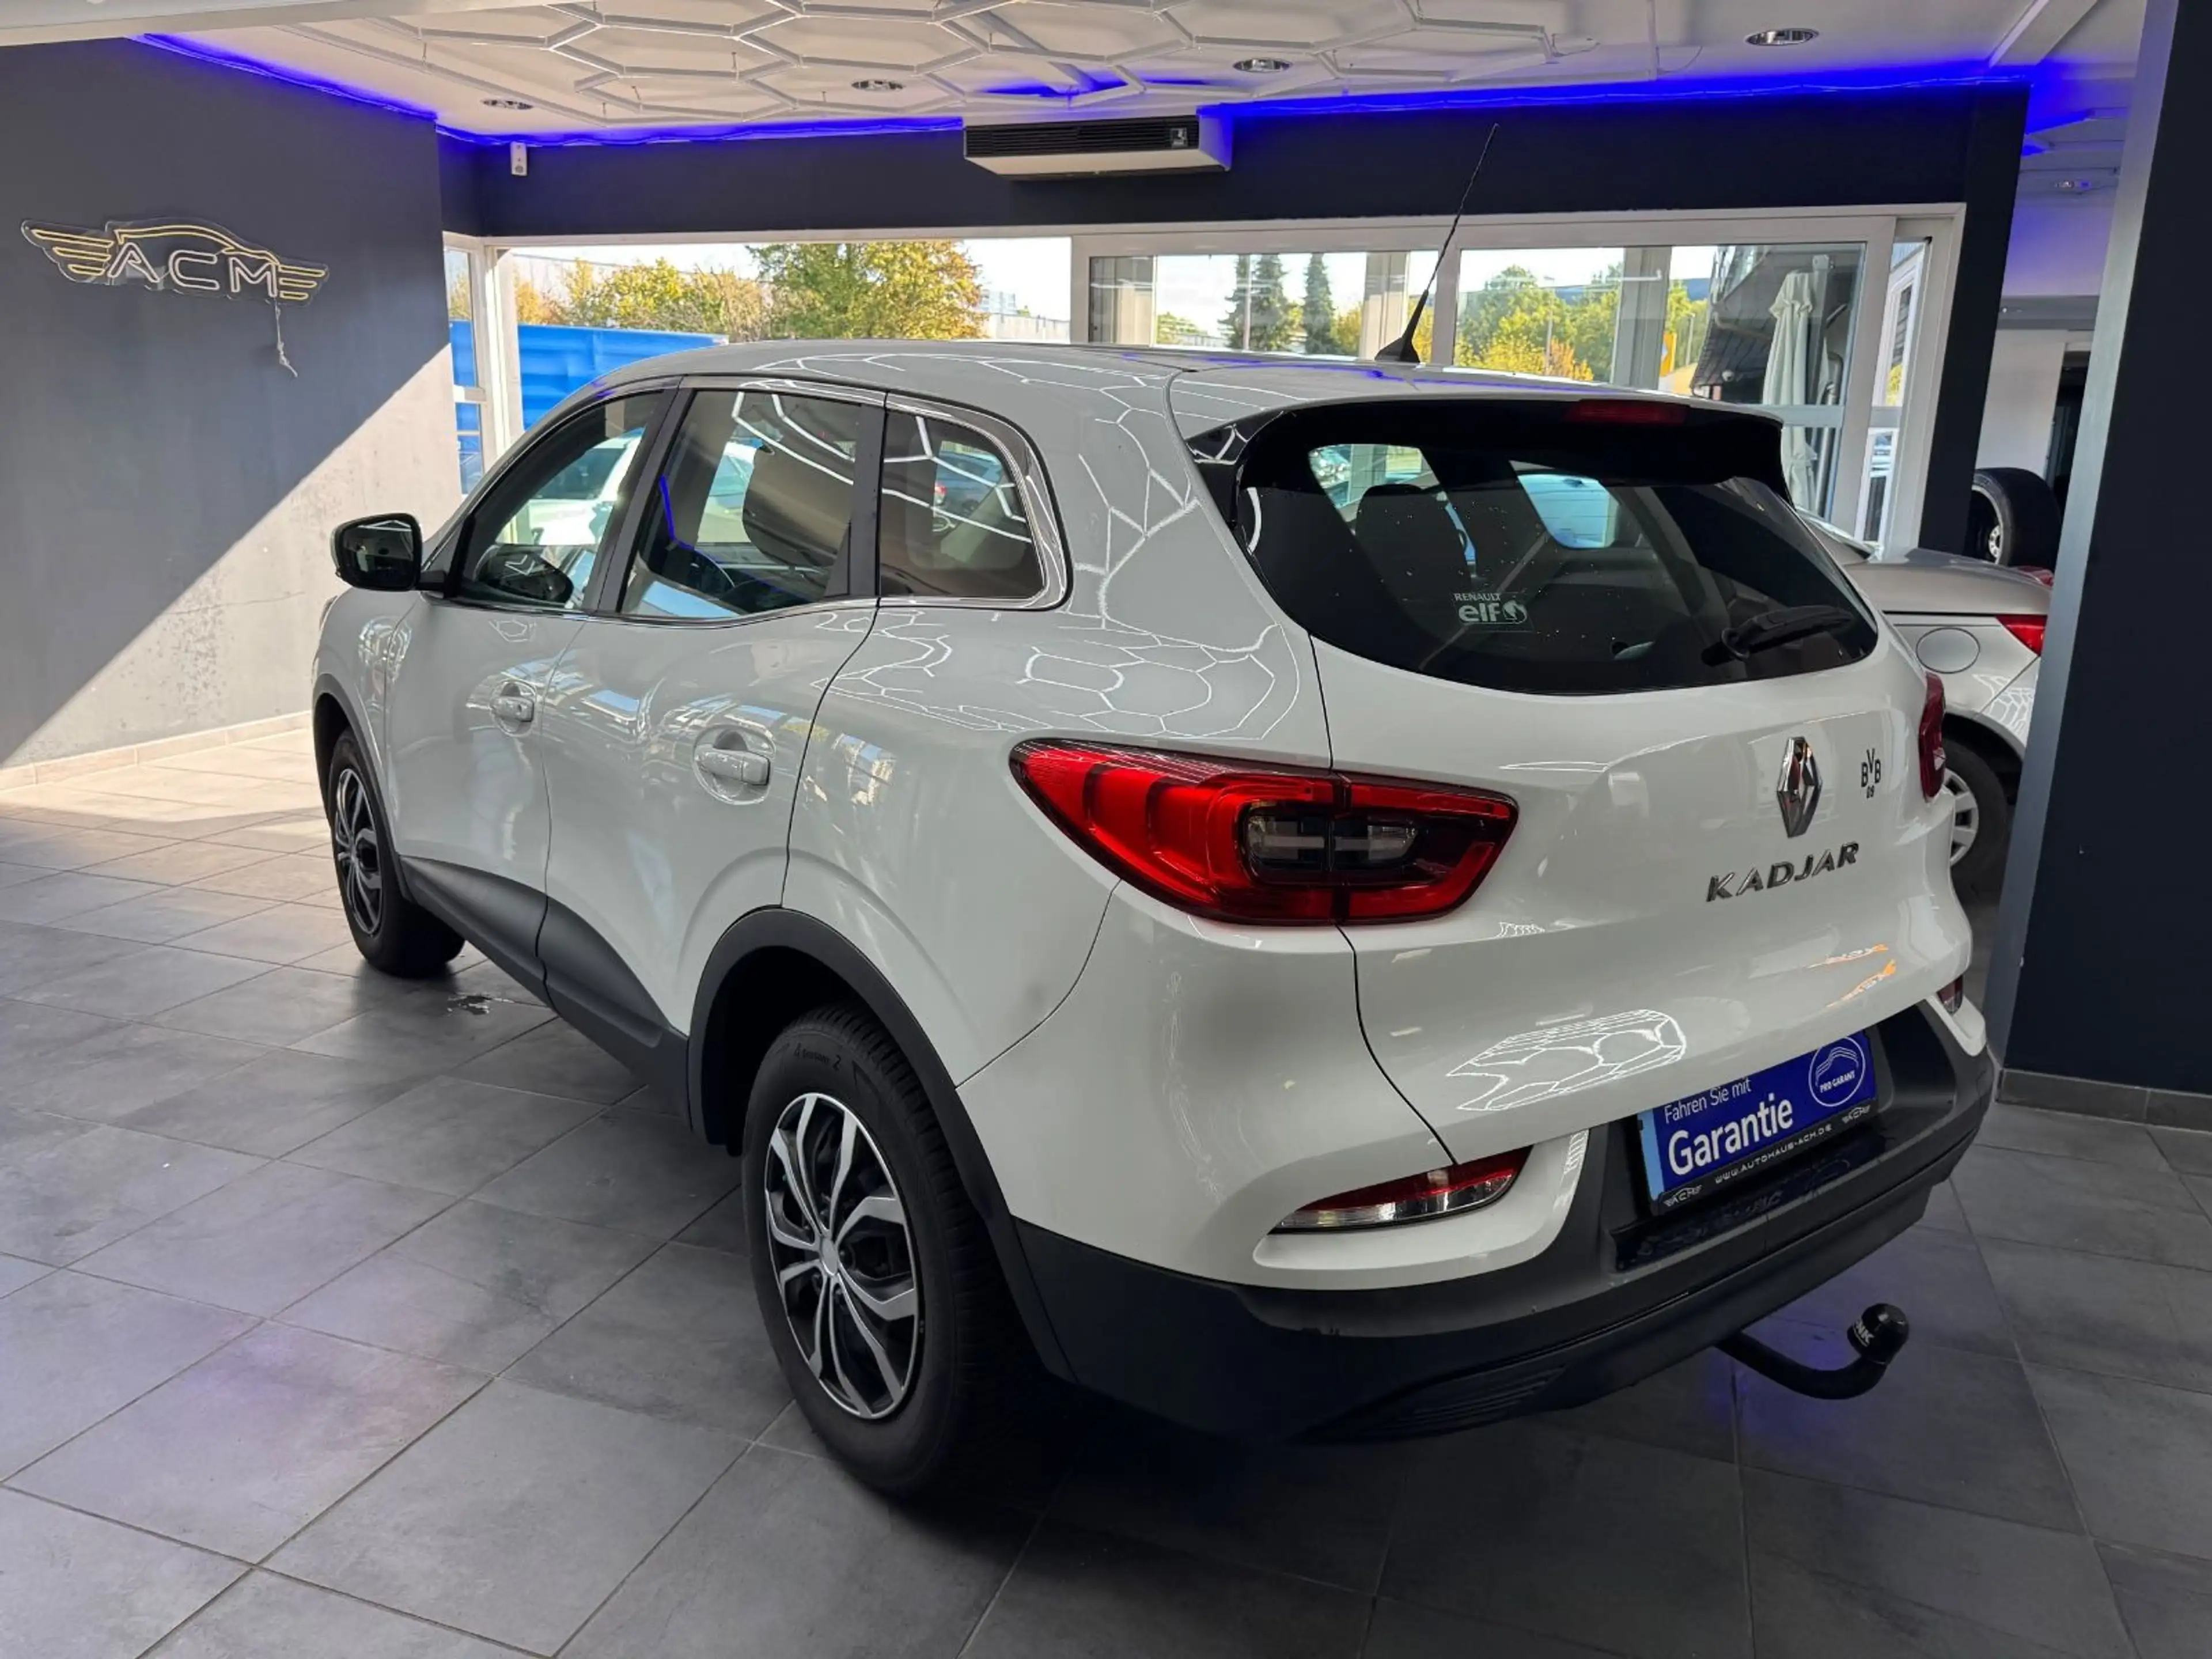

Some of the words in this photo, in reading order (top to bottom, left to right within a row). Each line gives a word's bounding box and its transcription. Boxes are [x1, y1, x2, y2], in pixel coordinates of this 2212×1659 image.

[107, 242, 277, 298] ACM
[1453, 593, 1501, 601] RENAULT
[1458, 603, 1500, 622] elf
[1861, 748, 1881, 787] BVB
[1706, 841, 1859, 902] KADJAR
[1664, 1100, 1708, 1124] Fahren
[1709, 1086, 1729, 1106] Sie
[1732, 1076, 1752, 1099] mit
[1668, 1093, 1793, 1176] Garantie
